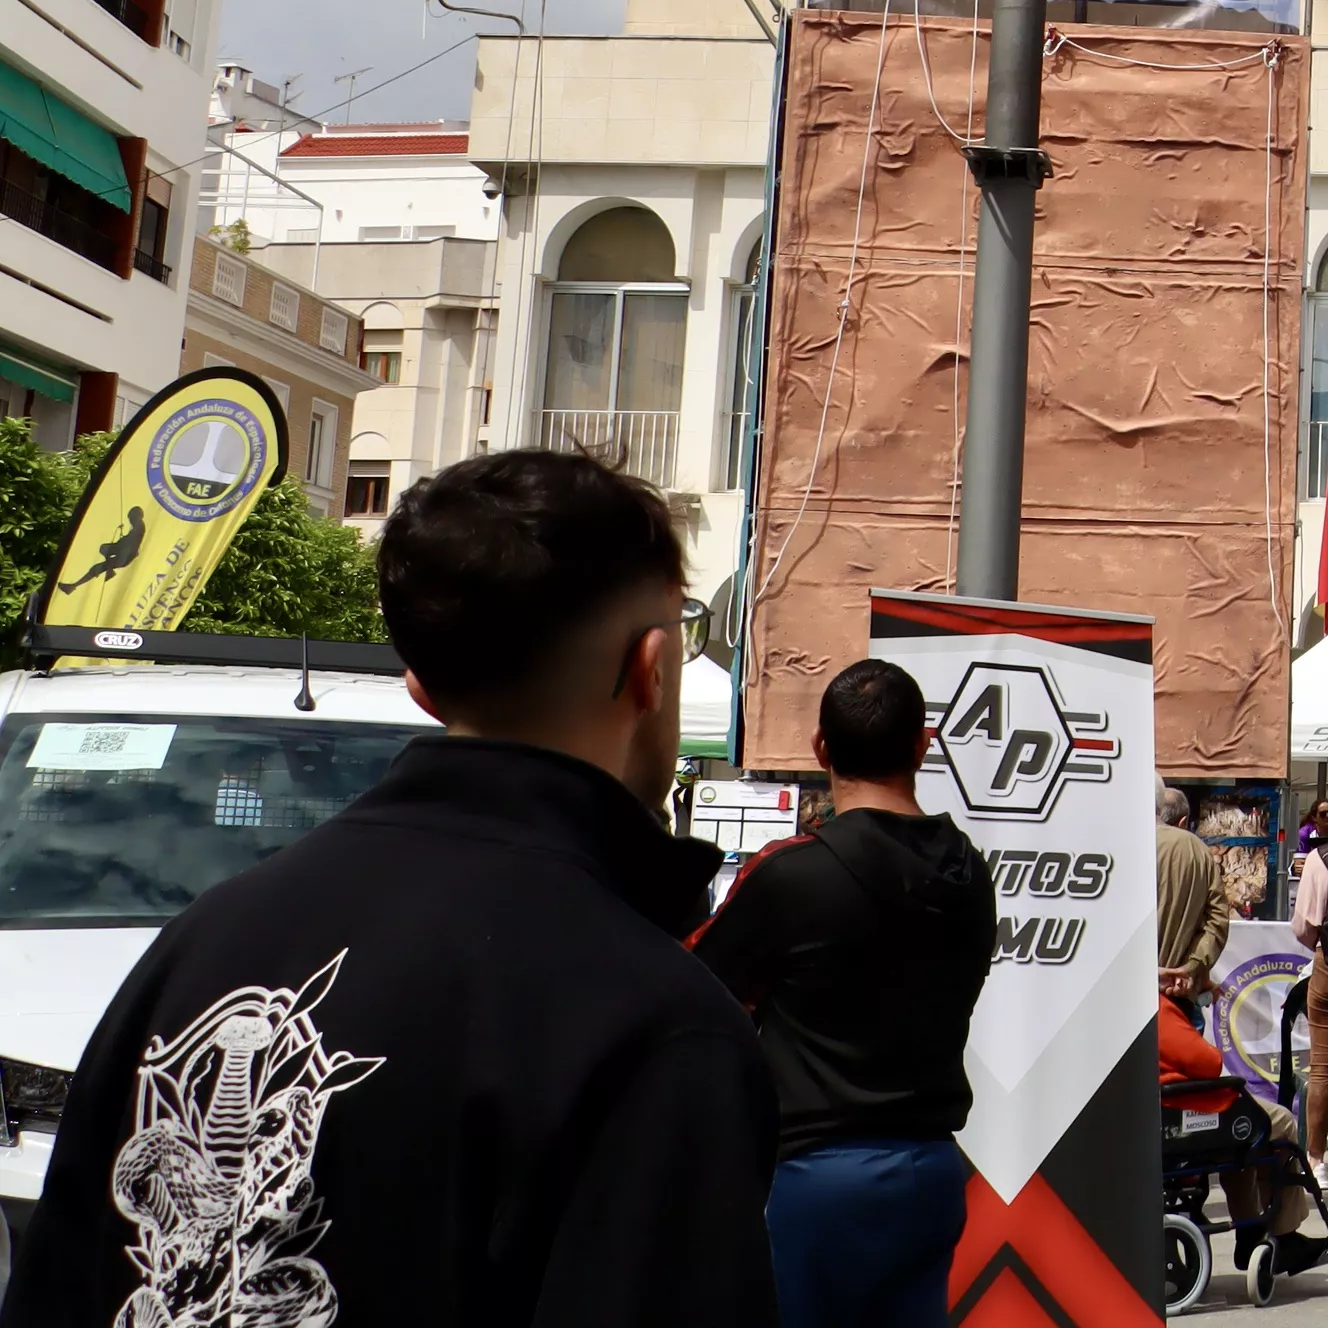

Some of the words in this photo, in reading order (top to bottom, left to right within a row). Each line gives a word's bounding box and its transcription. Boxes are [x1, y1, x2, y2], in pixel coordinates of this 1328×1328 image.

[151, 416, 186, 469] Federación
[186, 403, 235, 418] Andaluza
[235, 411, 248, 422] de
[186, 482, 211, 497] FAE
[166, 538, 190, 567] DE
[99, 636, 139, 647] CRUZ
[1236, 961, 1293, 985] Andaluza
